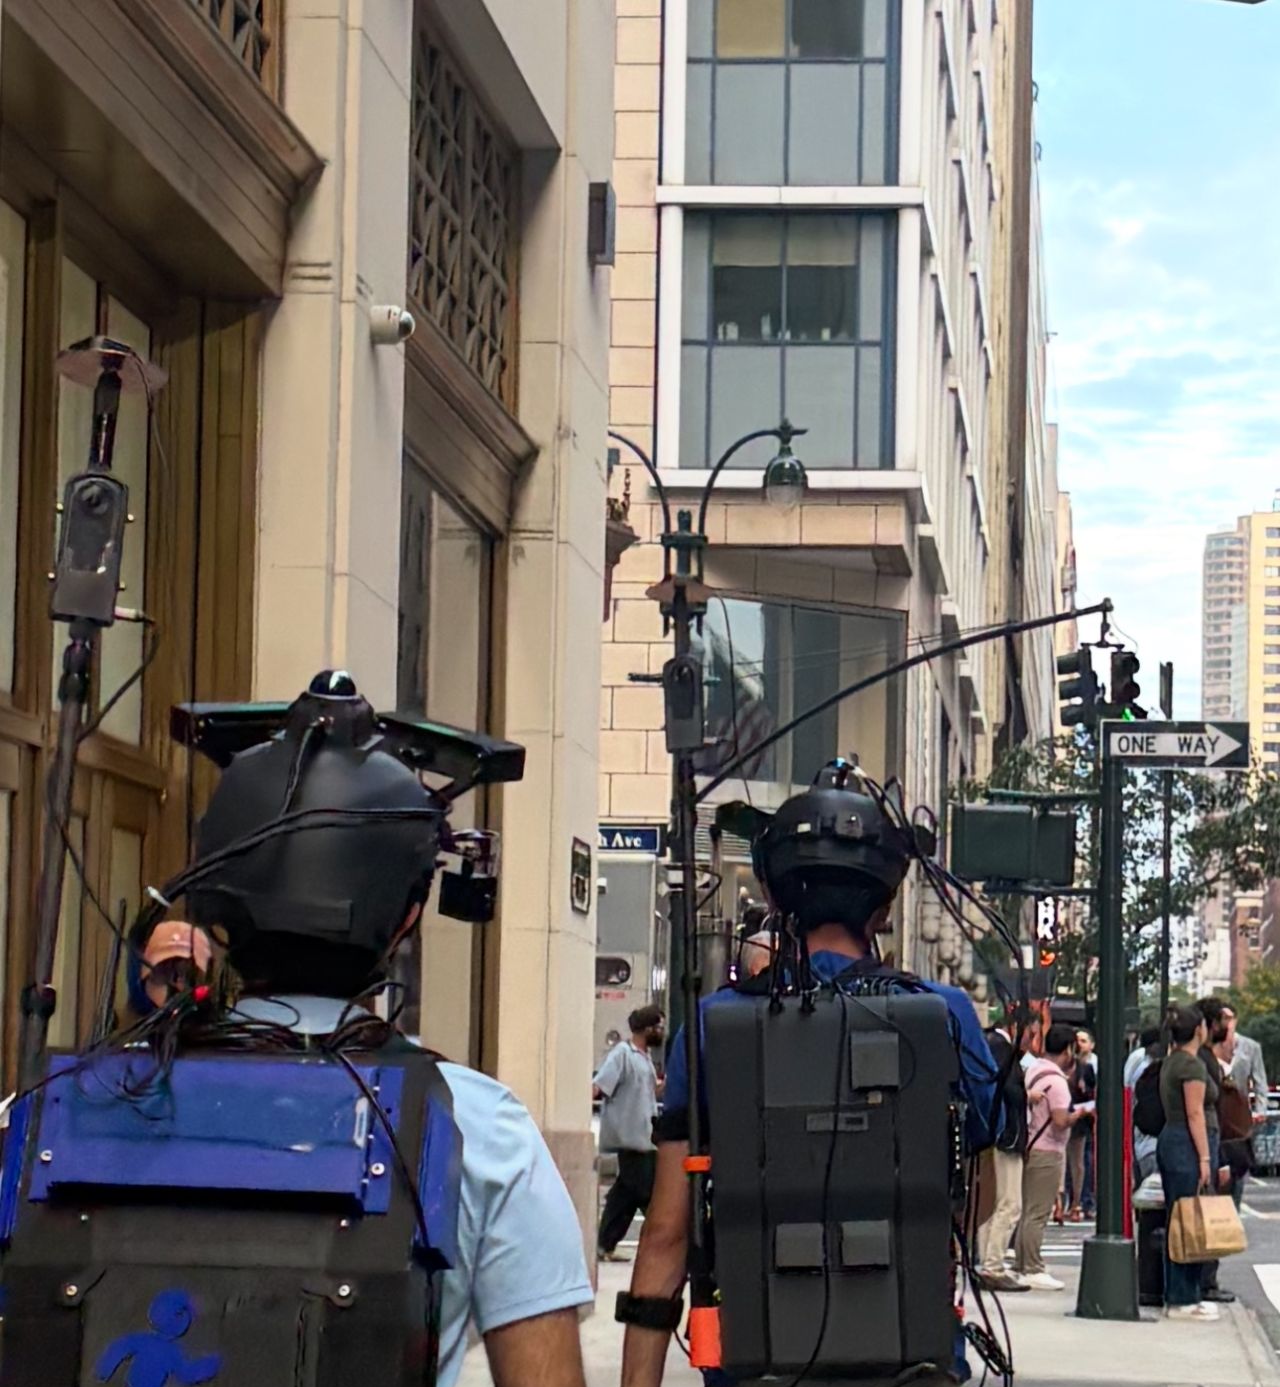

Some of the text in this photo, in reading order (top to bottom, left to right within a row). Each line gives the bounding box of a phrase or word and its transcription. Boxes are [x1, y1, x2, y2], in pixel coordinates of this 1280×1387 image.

[1118, 735, 1220, 754] ONE WAY
[611, 832, 642, 848] Ave
